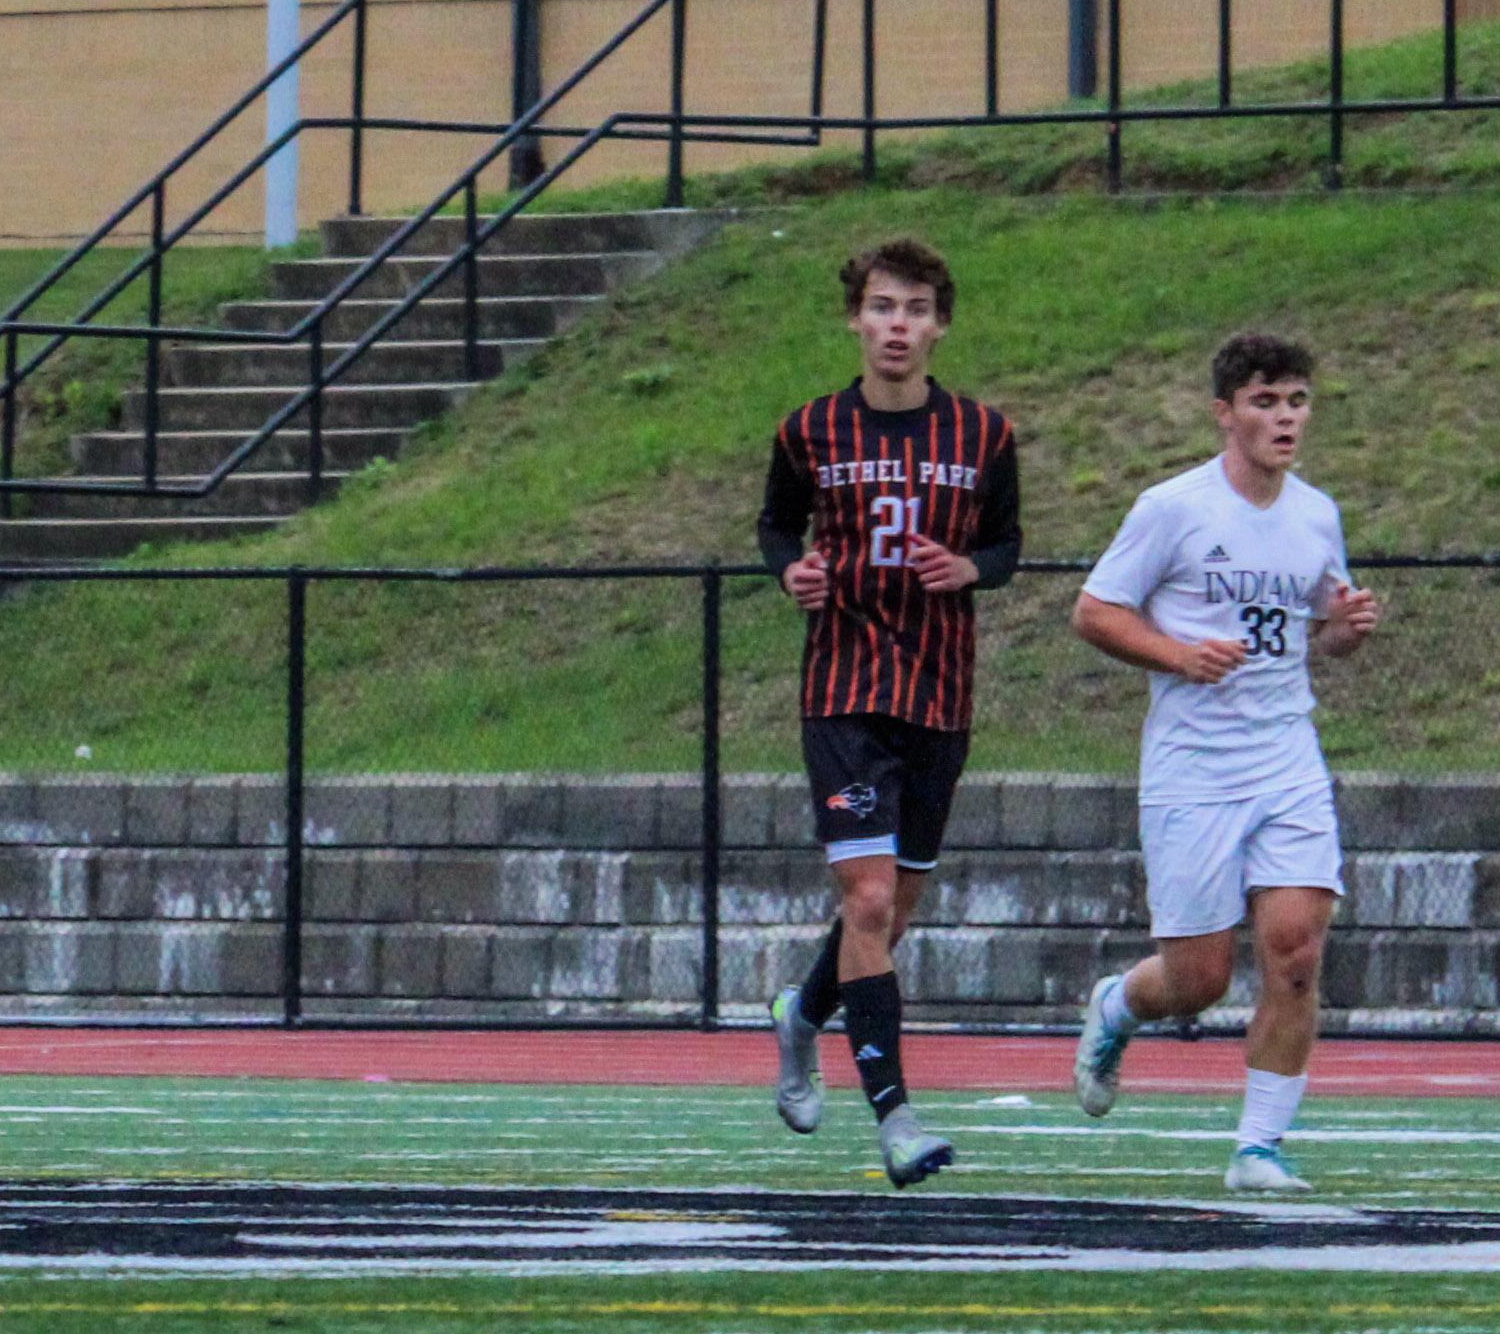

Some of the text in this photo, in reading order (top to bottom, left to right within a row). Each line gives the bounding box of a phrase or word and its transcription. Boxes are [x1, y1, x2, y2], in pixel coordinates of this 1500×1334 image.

[817, 459, 978, 490] BETHEL PARK
[870, 496, 922, 566] 21
[1204, 570, 1309, 609] INDIAN
[1240, 606, 1287, 657] 33
